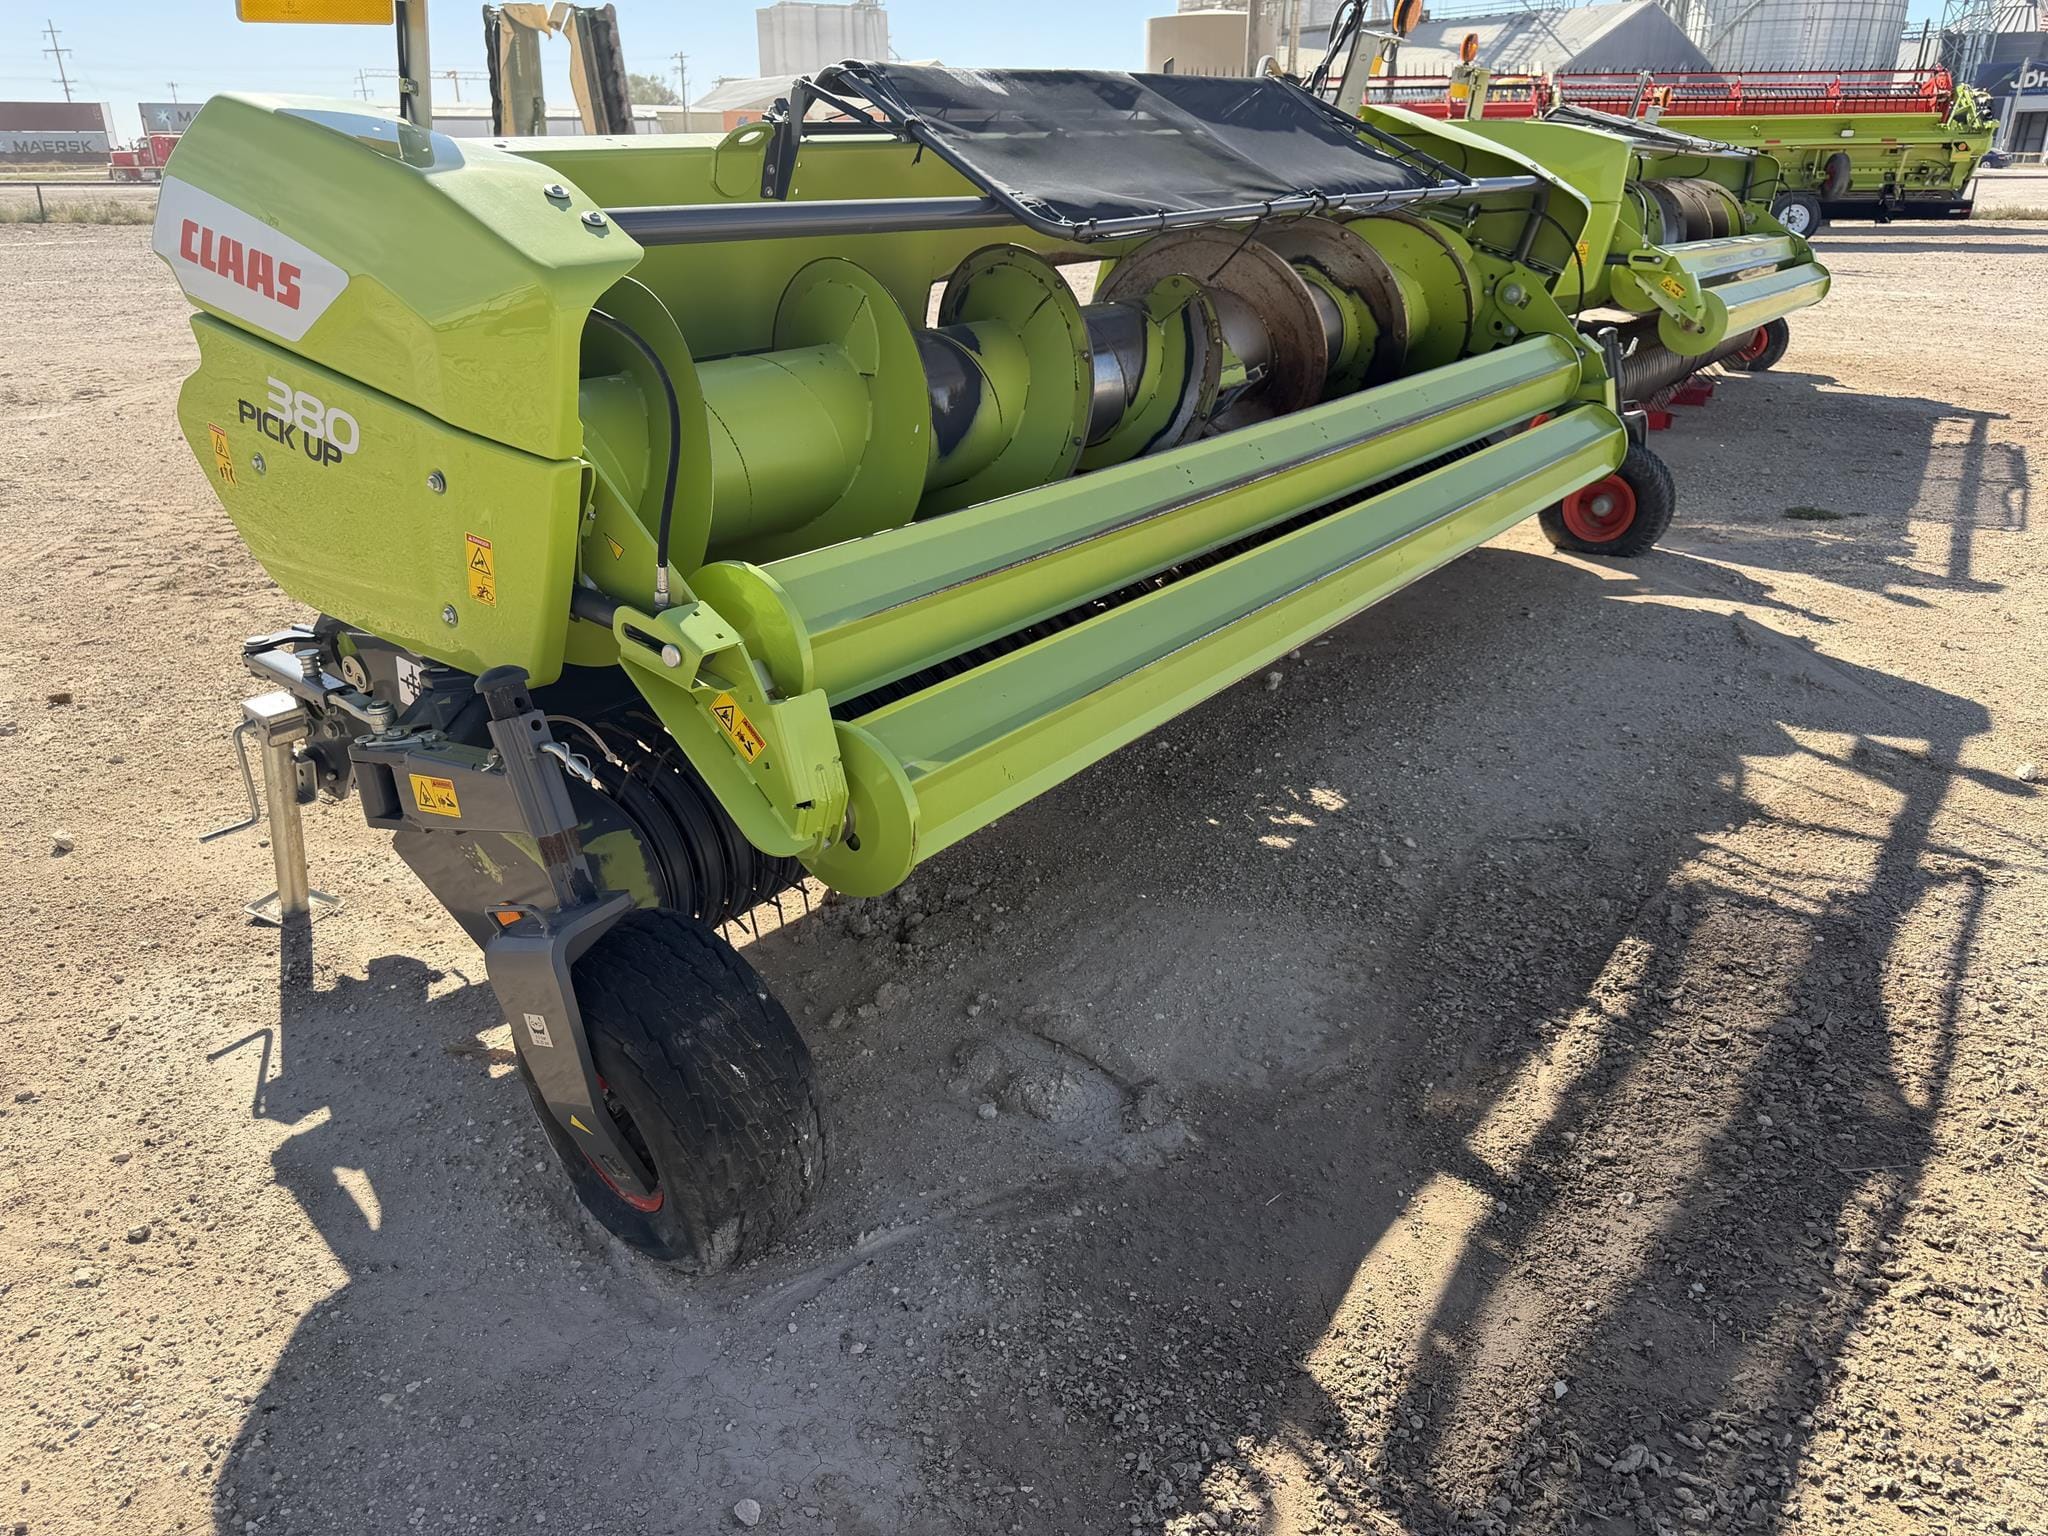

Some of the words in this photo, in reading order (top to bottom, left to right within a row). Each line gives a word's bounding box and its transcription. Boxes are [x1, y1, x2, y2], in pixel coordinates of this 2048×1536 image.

[13, 140, 93, 153] MAERSK
[180, 219, 301, 310] CLAAS
[238, 398, 296, 450] PICK
[304, 431, 342, 467] UP
[267, 375, 360, 454] 380
